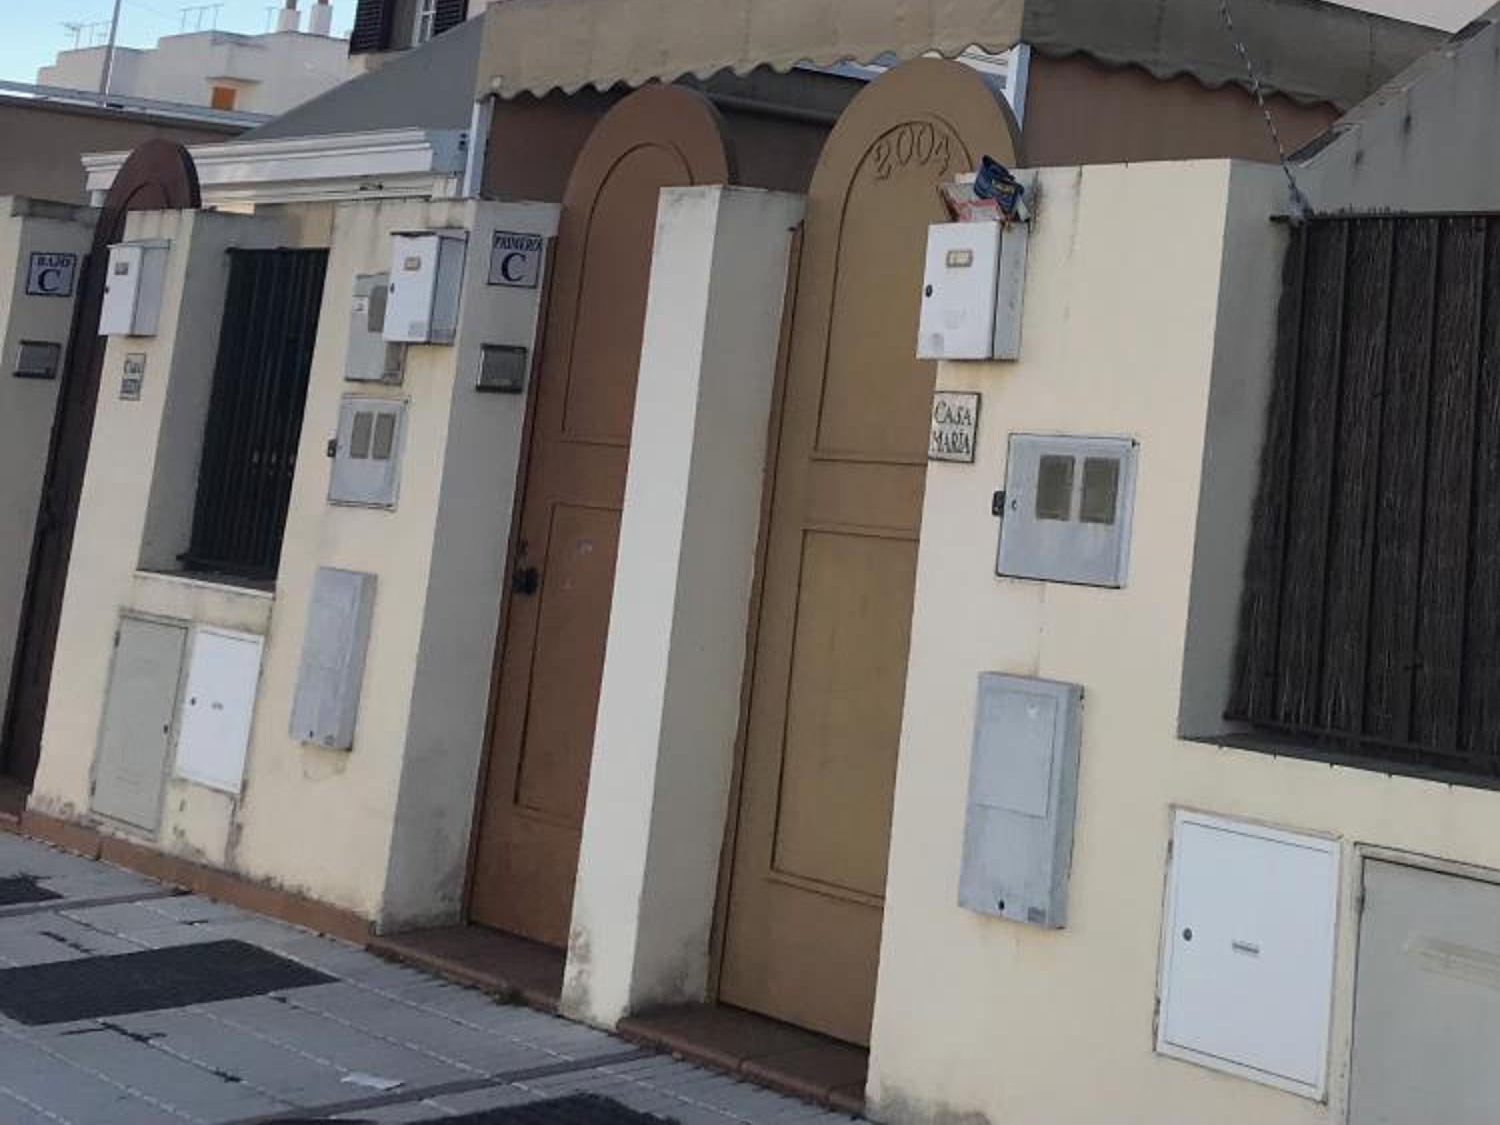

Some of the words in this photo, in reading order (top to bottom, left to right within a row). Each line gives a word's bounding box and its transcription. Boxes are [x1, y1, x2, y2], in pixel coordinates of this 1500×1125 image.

[874, 123, 951, 181] 2004
[38, 268, 61, 292] C
[501, 252, 527, 282] C
[934, 400, 972, 426] CASA
